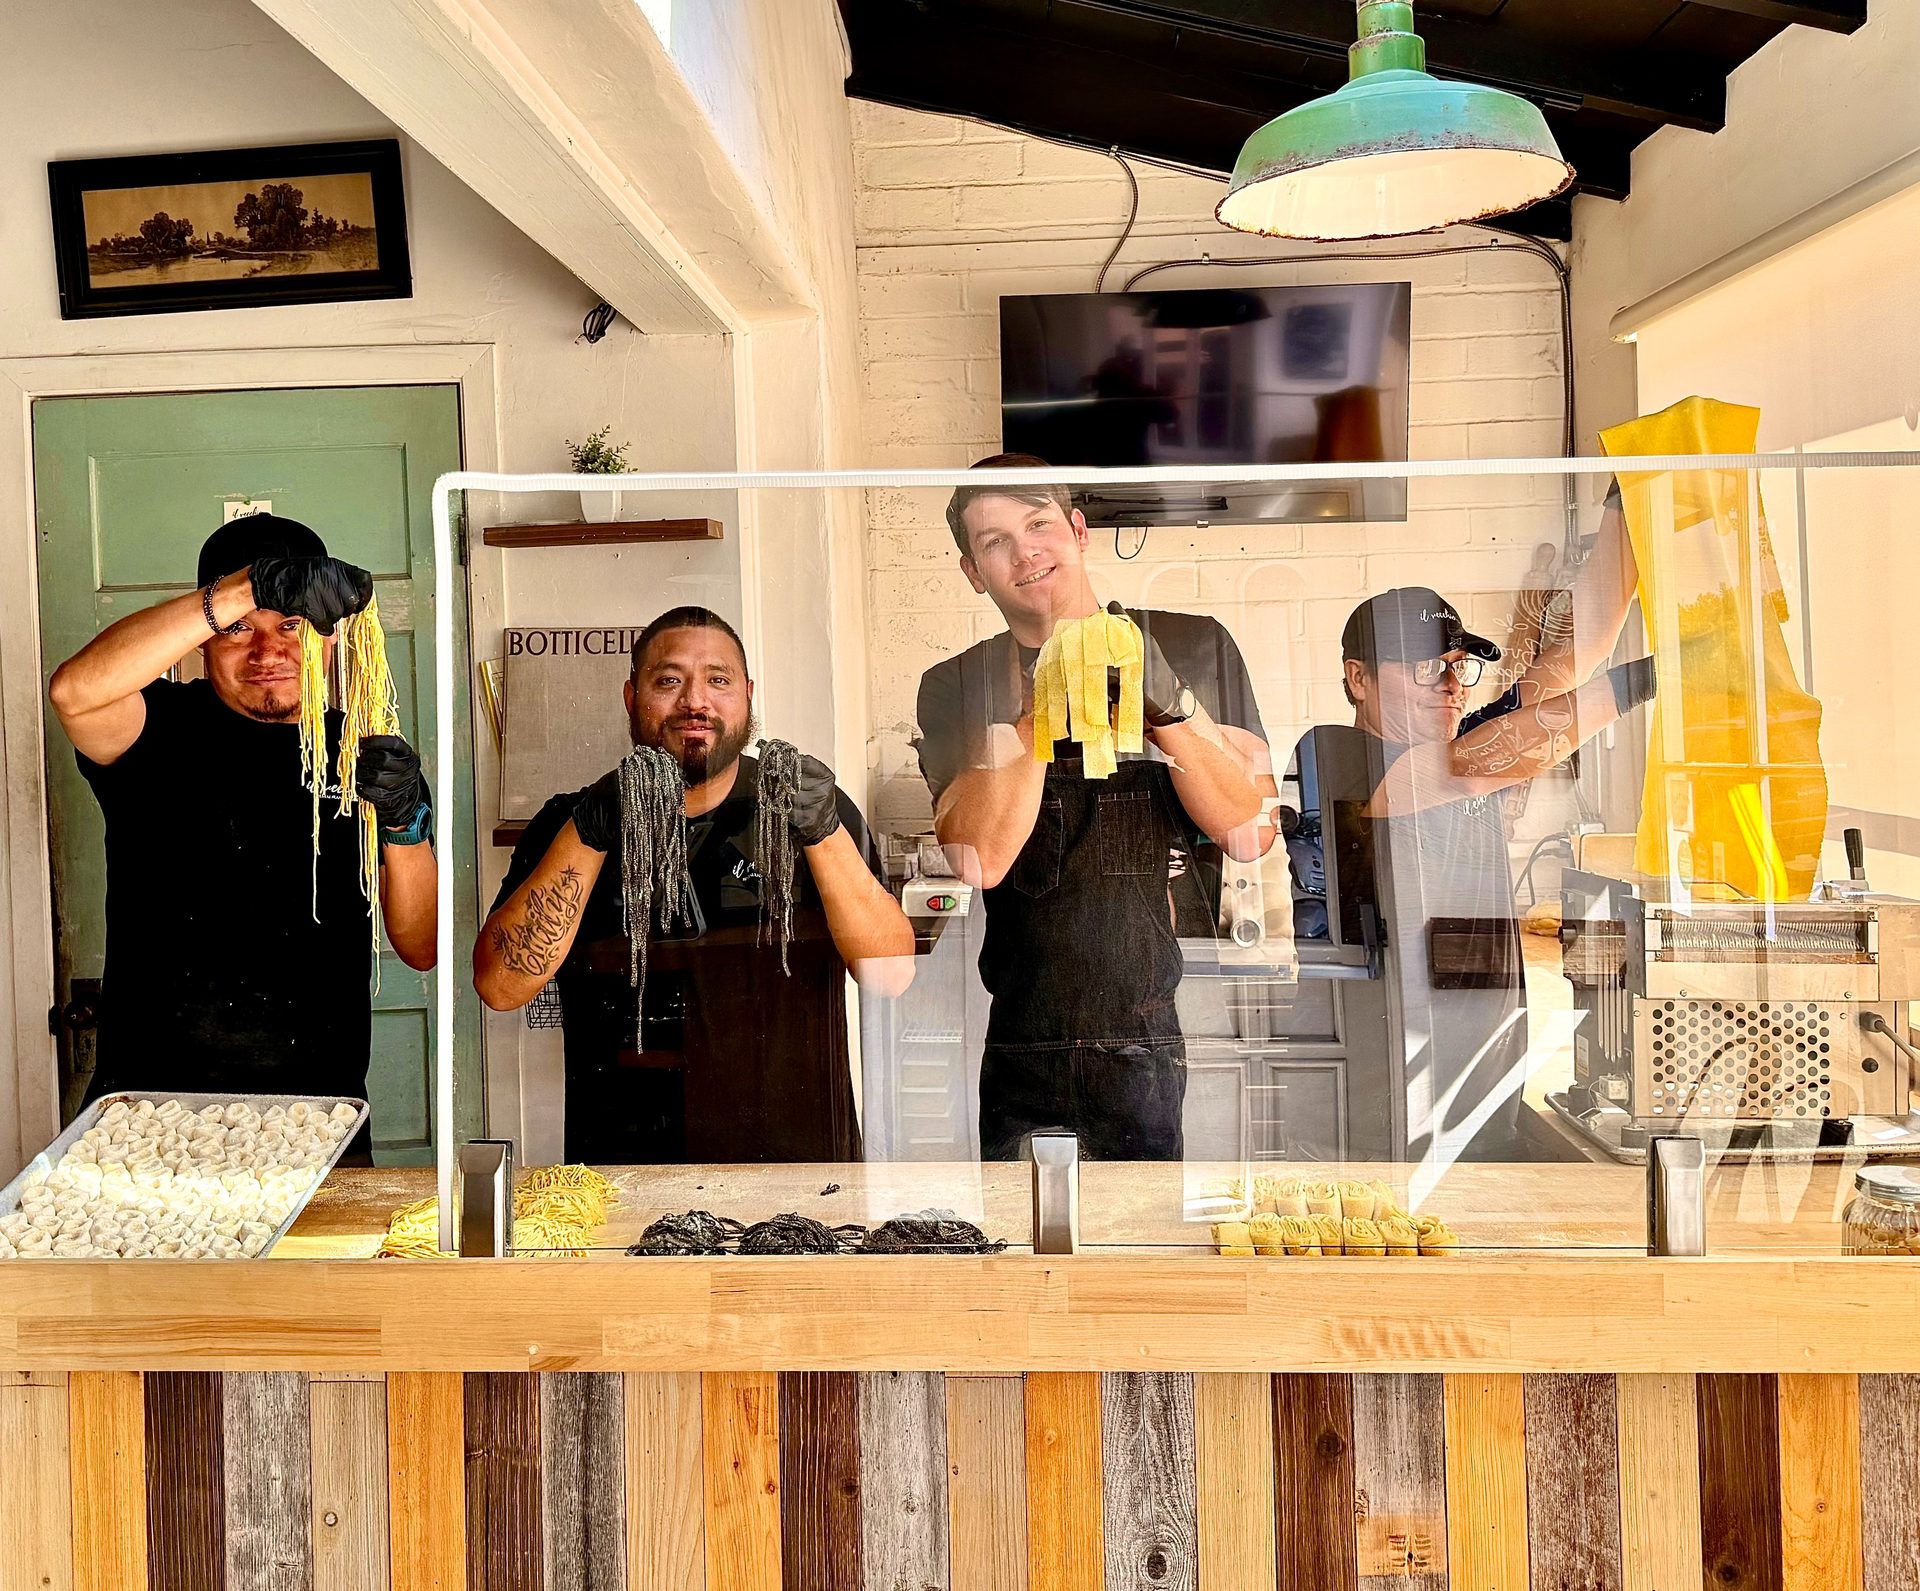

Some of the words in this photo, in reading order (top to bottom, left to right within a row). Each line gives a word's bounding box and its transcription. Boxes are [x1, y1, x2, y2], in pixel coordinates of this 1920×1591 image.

[1420, 608, 1430, 623] il
[508, 630, 645, 656] BOTTICELL
[732, 859, 745, 879] il
